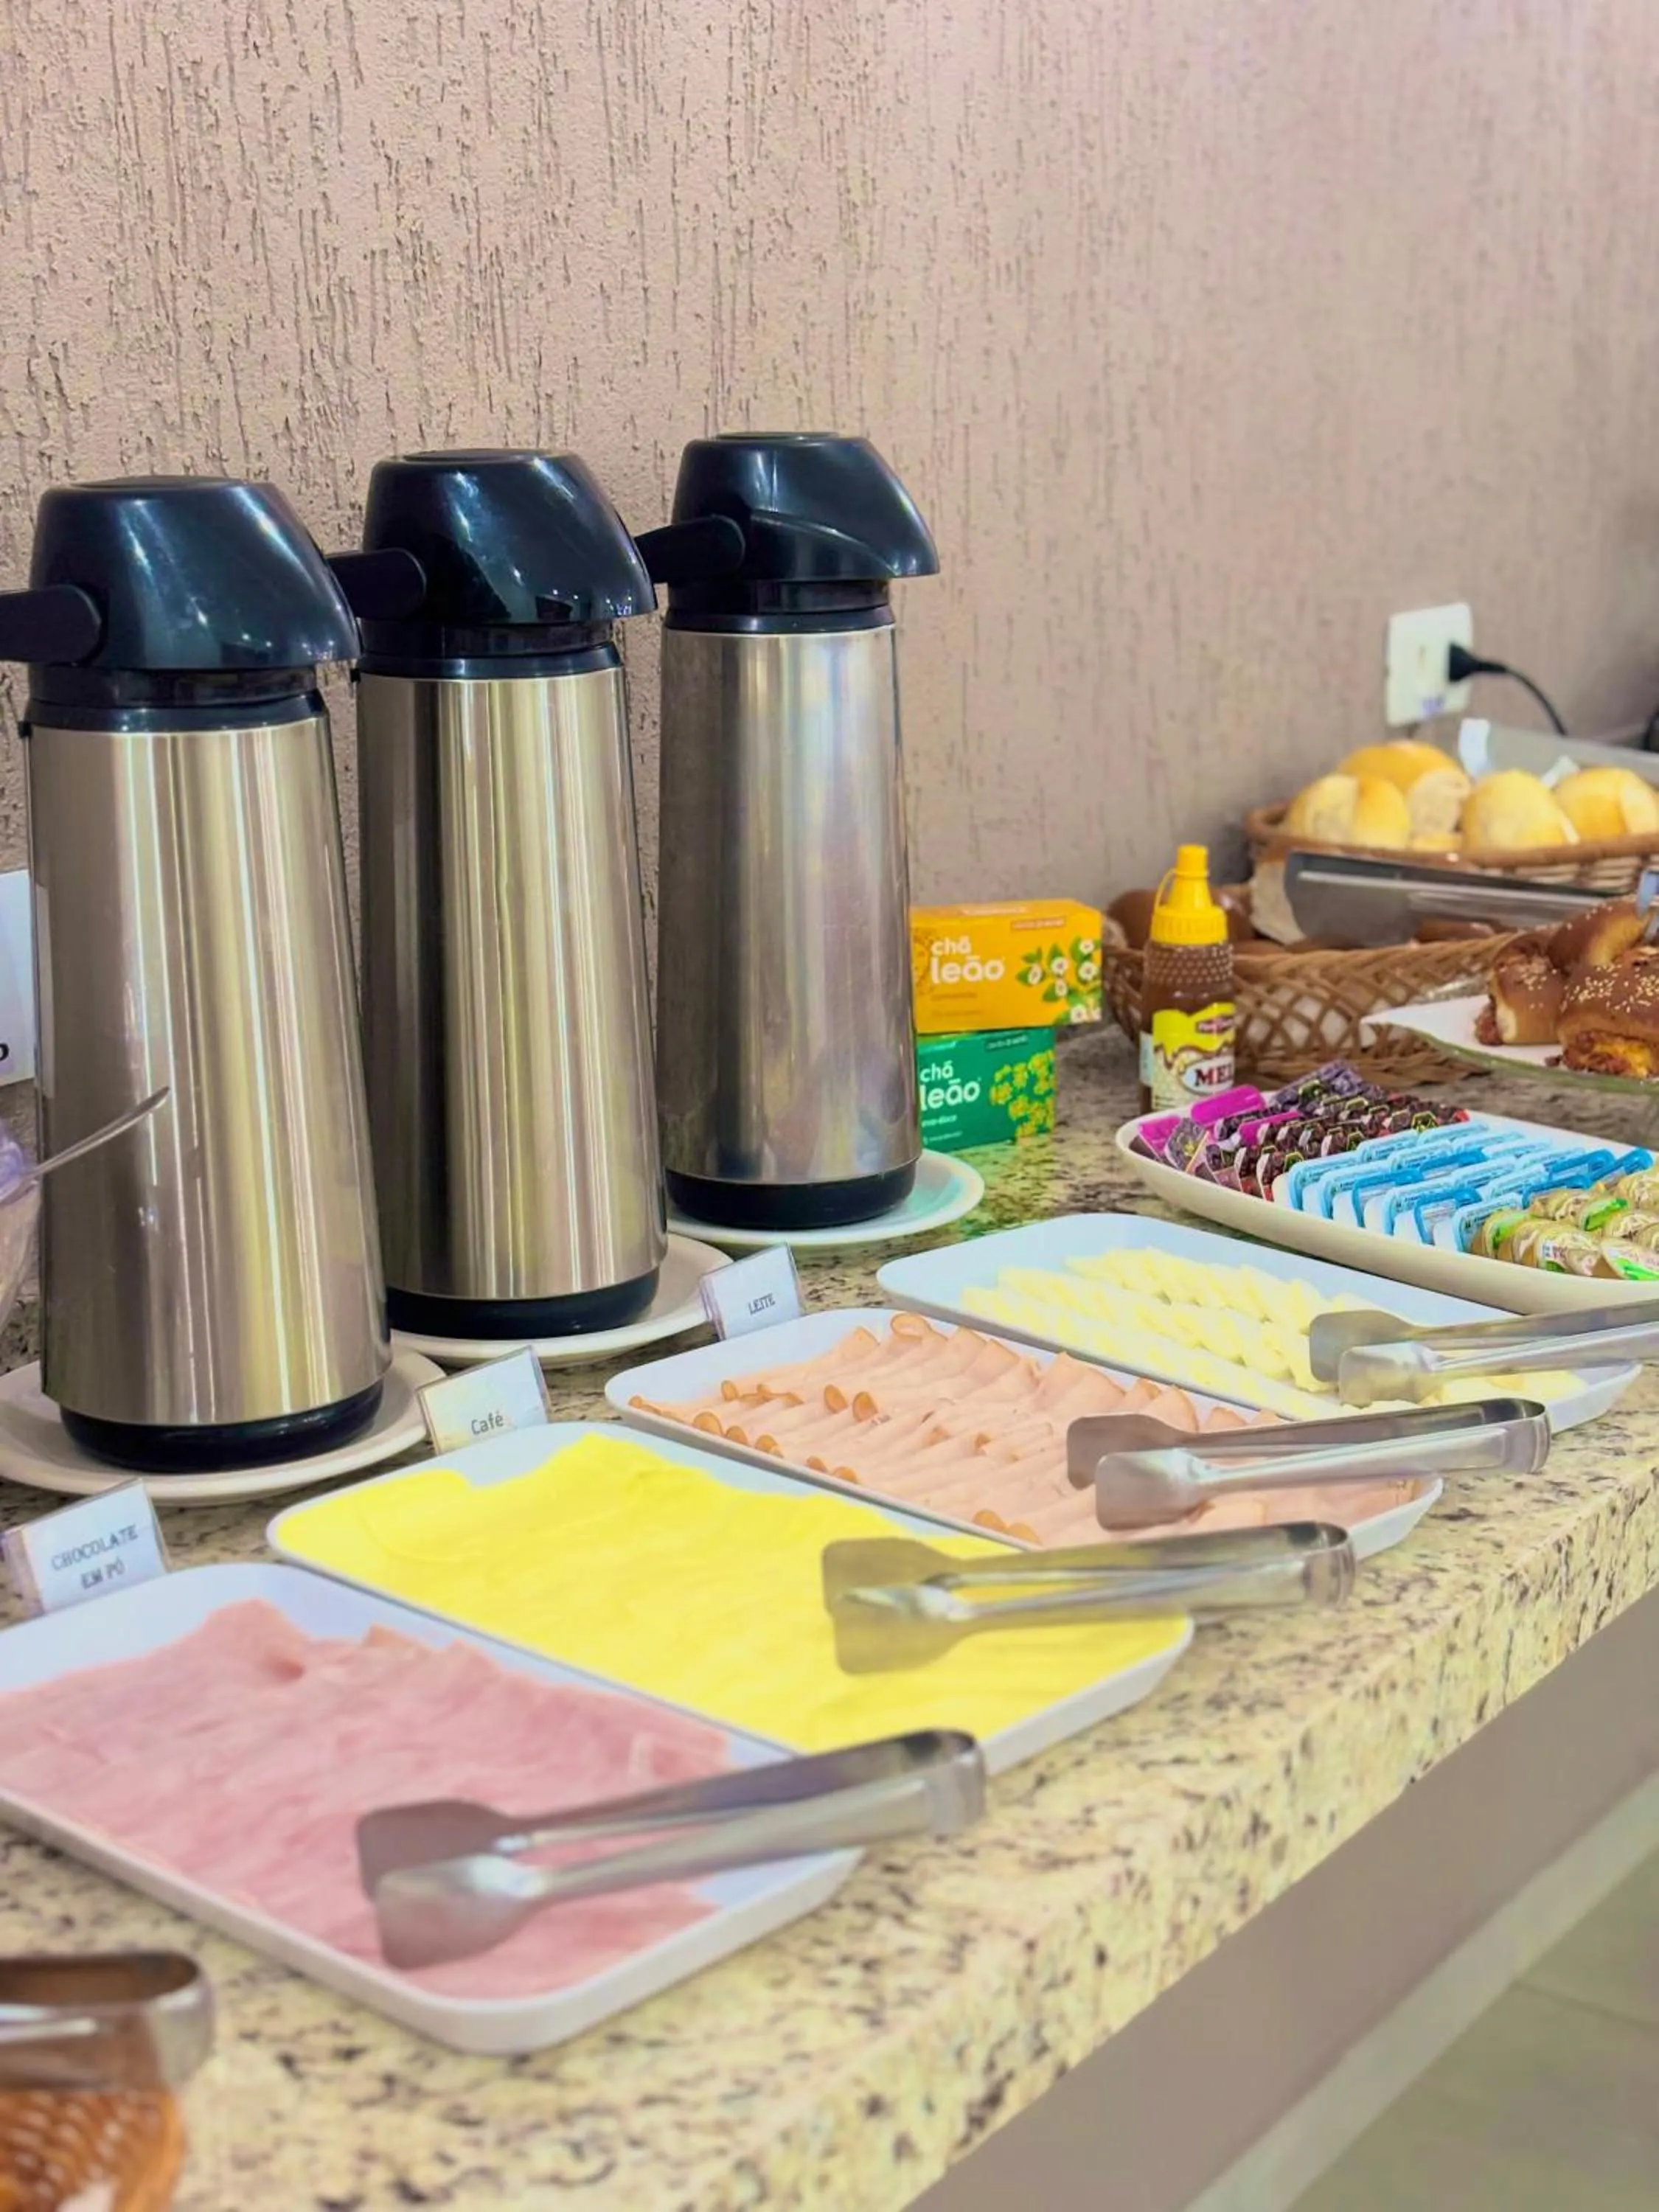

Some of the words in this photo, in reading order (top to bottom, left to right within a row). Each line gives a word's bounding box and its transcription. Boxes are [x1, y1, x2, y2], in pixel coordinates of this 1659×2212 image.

[931, 936, 972, 956] chá
[931, 956, 1005, 984] leão
[919, 1060, 953, 1082] chá
[919, 1078, 981, 1111] leão
[748, 1292, 776, 1315] LEITE
[471, 1410, 504, 1436] Café
[51, 1523, 139, 1571] CHOCOLATE
[80, 1568, 104, 1590] EM
